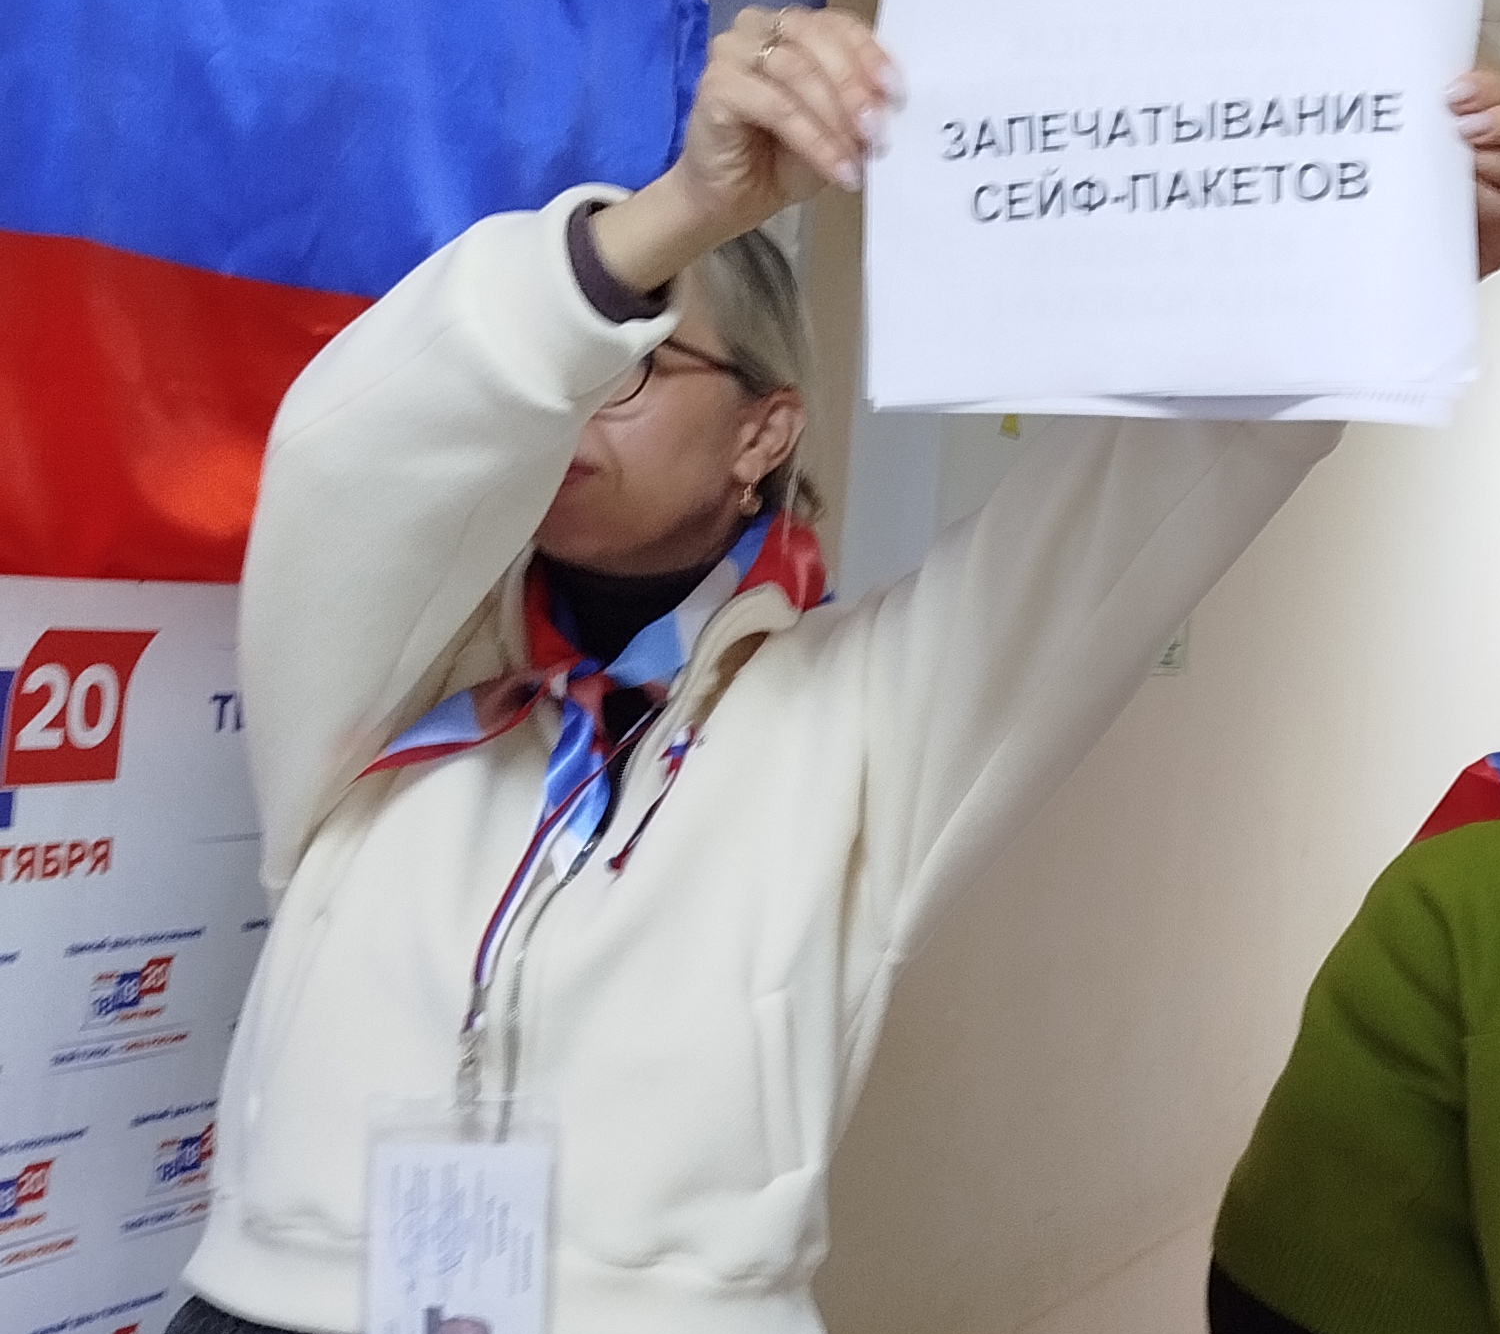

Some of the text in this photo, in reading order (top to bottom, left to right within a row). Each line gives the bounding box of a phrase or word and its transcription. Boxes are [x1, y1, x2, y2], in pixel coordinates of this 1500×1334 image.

[942, 91, 1403, 160] ЗАПЕЧАТЫВАНИЕ
[971, 161, 1370, 223] СЕЙФ-ПАКЕТОВ
[14, 663, 119, 750] 20
